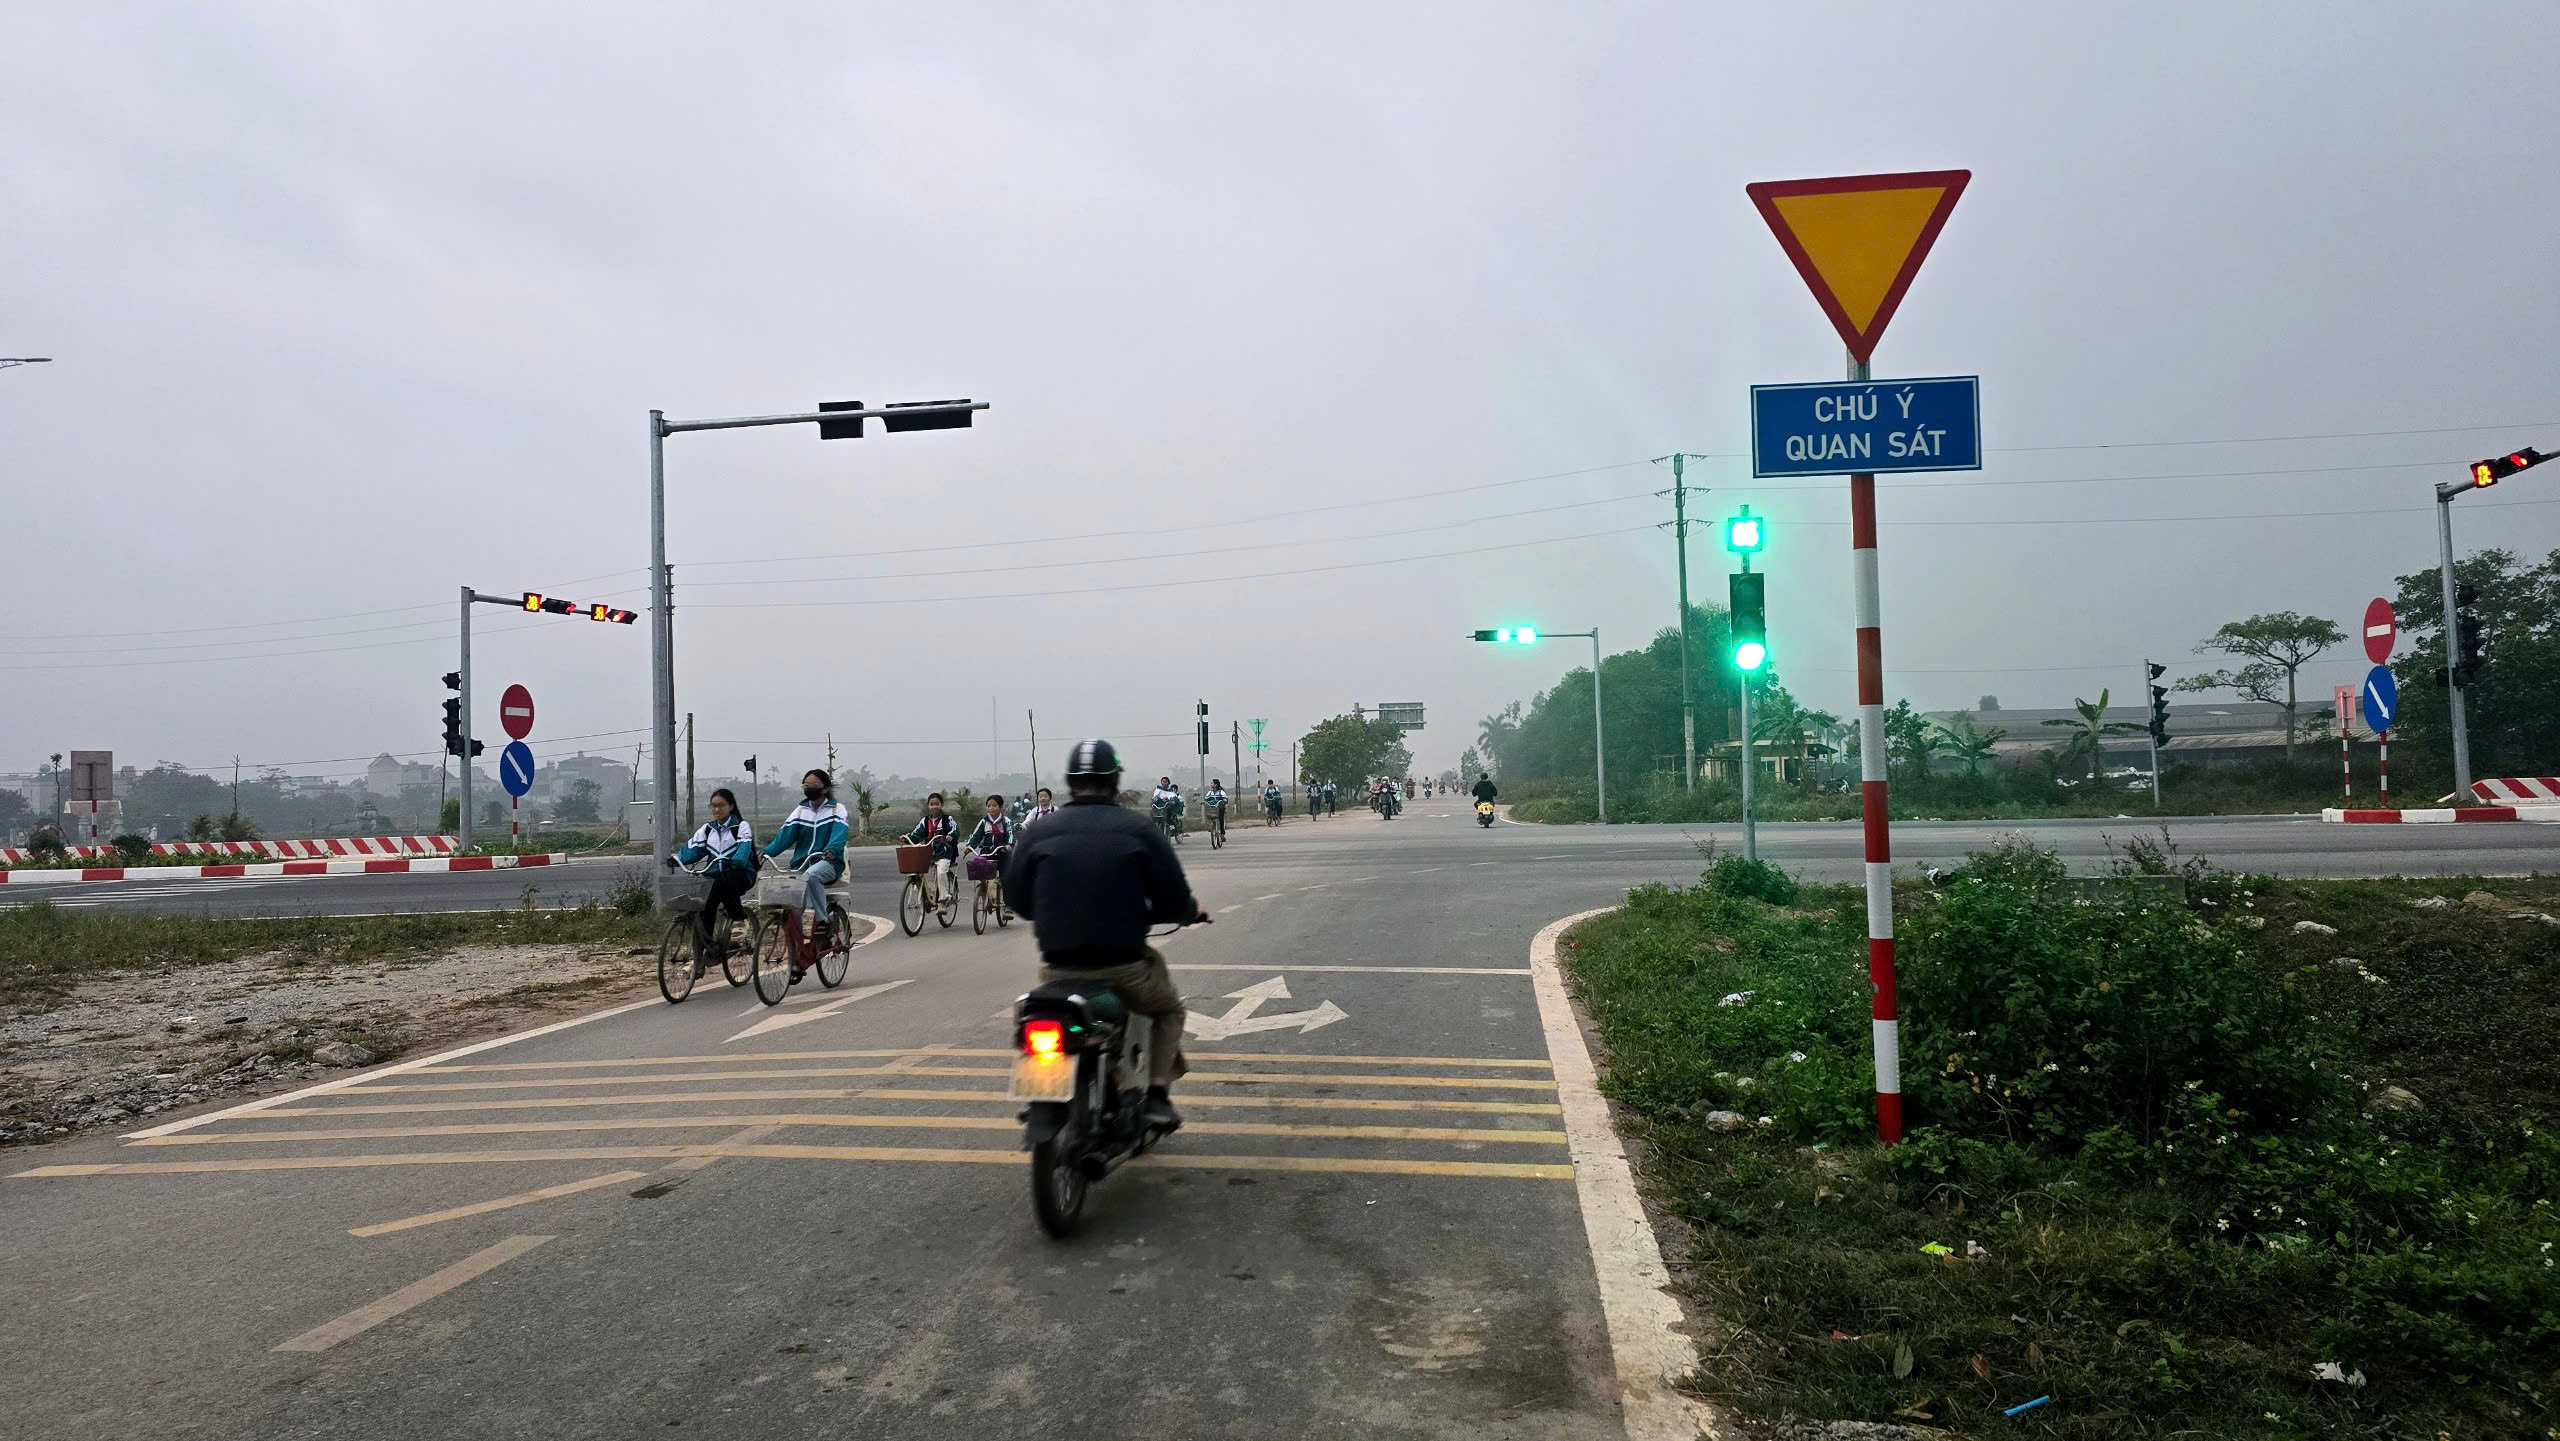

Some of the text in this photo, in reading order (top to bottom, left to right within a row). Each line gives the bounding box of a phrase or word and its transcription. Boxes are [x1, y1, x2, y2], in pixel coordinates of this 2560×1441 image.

[1815, 386, 1915, 422] CHÚ Ý
[1786, 424, 1947, 461] QUAN SÁT
